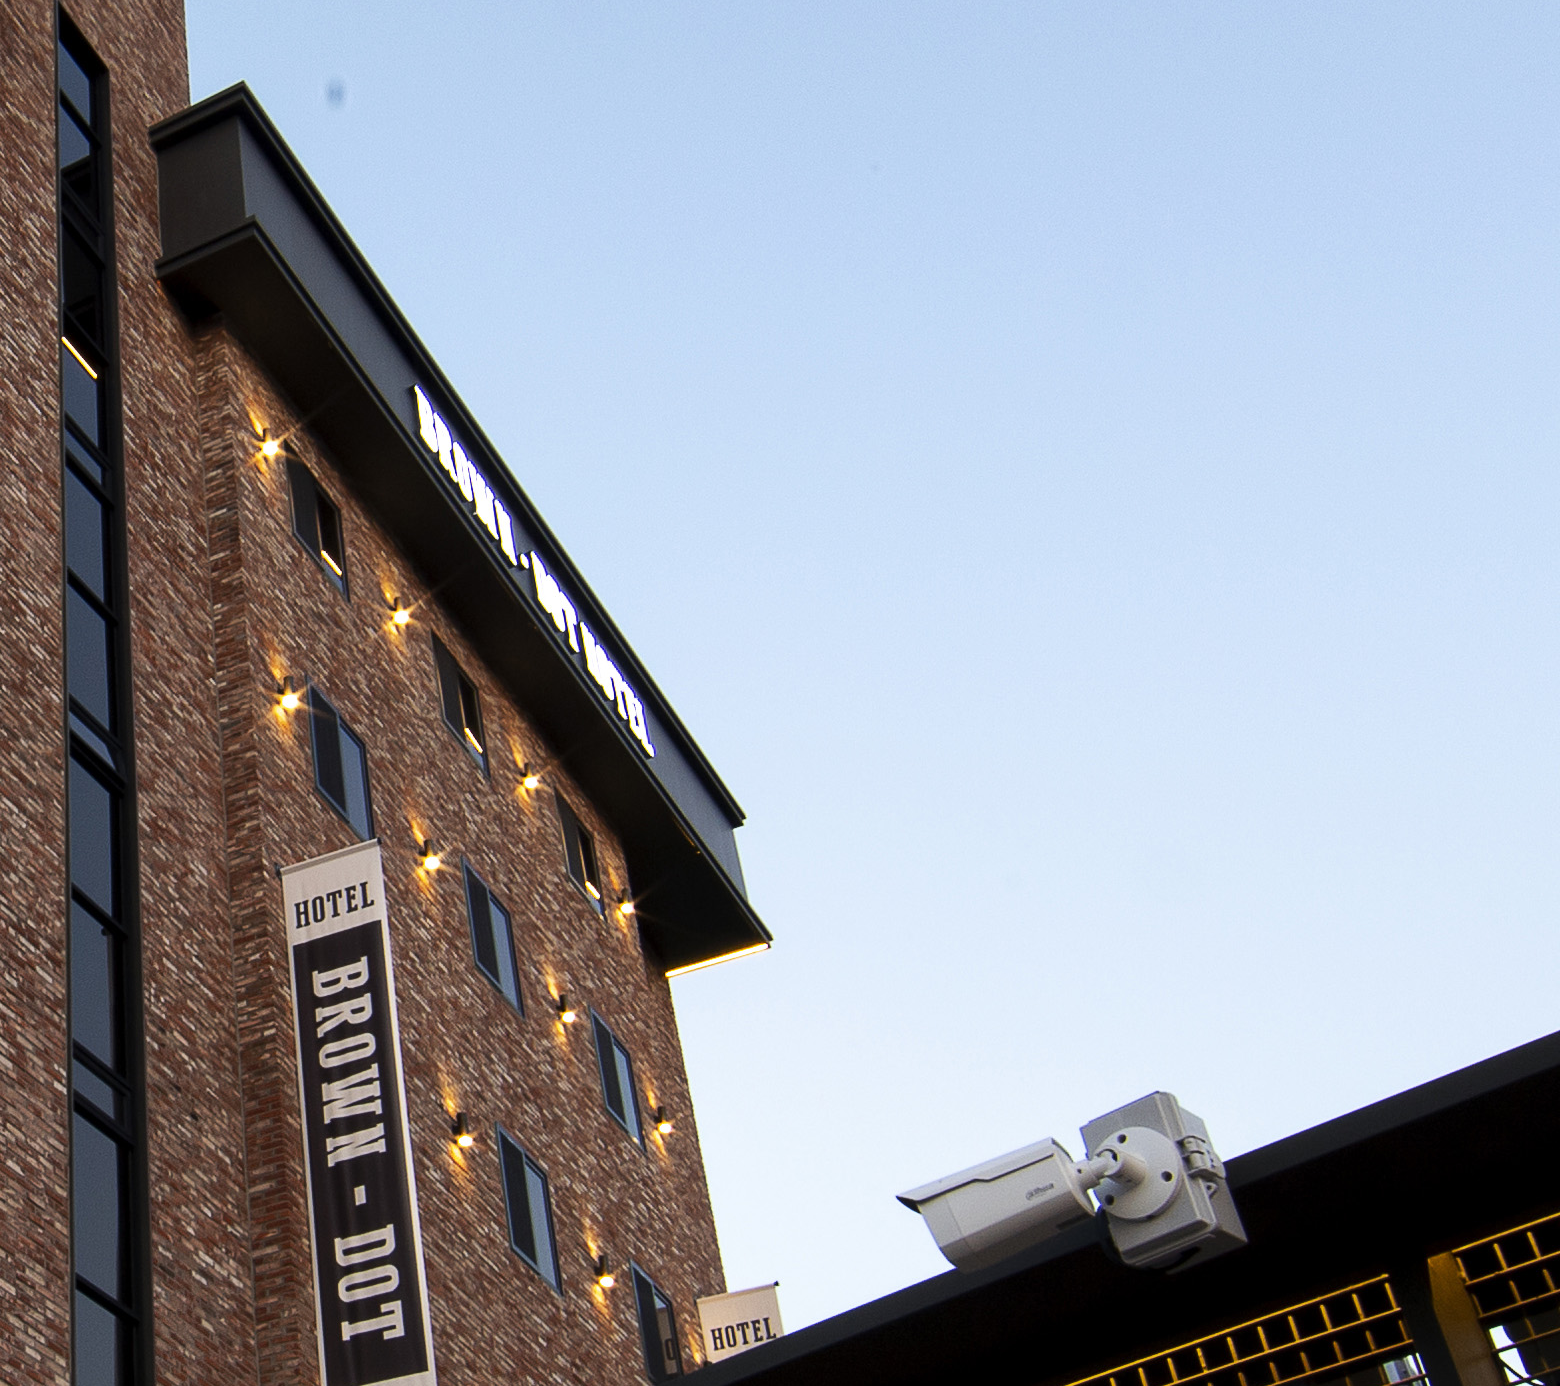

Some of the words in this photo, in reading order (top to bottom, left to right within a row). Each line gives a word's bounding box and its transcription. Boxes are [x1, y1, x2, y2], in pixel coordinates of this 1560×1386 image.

[414, 384, 518, 566] BROWN
[293, 880, 376, 930] HOTEL
[311, 955, 387, 1168] BROWN
[334, 1223, 405, 1342] DOT
[710, 1316, 777, 1352] HOTEL
